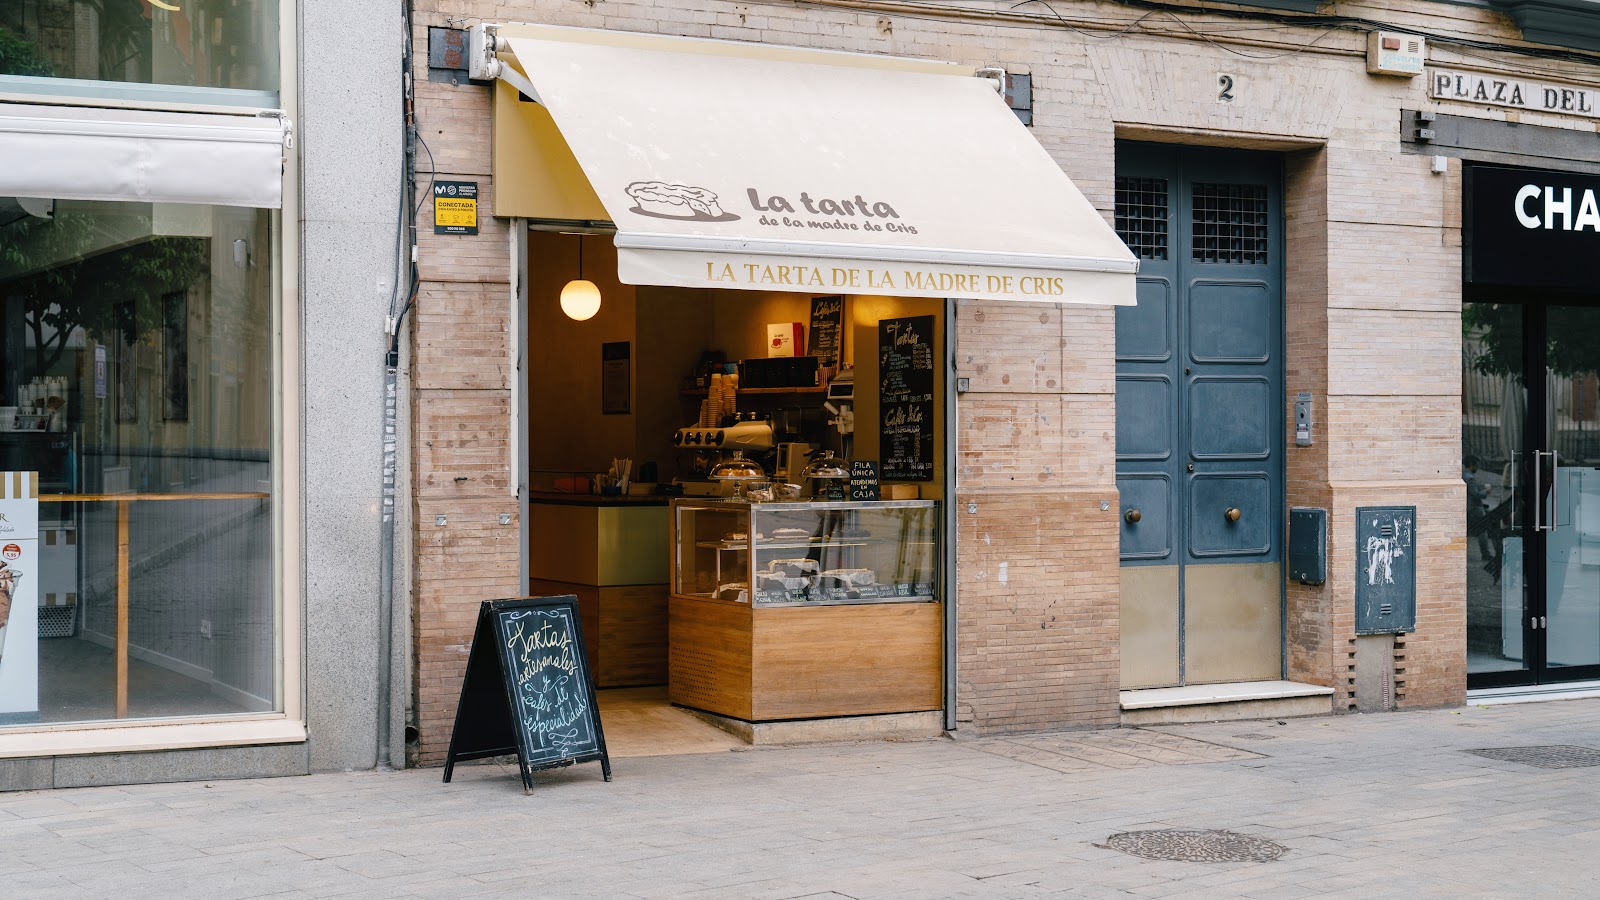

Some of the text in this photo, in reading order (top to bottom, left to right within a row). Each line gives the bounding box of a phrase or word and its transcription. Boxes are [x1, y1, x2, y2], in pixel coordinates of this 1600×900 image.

[1218, 75, 1233, 101] 2
[1436, 74, 1592, 113] PLAZA DEL
[747, 188, 900, 218] La tarta
[1514, 184, 1600, 232] CHA
[759, 215, 918, 235] de la madre de Cris
[706, 262, 1064, 295] LA TARTA DE LA MADRE DE CRIS
[887, 321, 919, 350] Tartas
[852, 468, 875, 476] ÚNICA
[852, 490, 875, 498] CAJA
[508, 620, 572, 662] Tartas
[518, 647, 578, 685] artesanales
[523, 685, 569, 721] cafés de
[524, 692, 588, 747] especialidad
